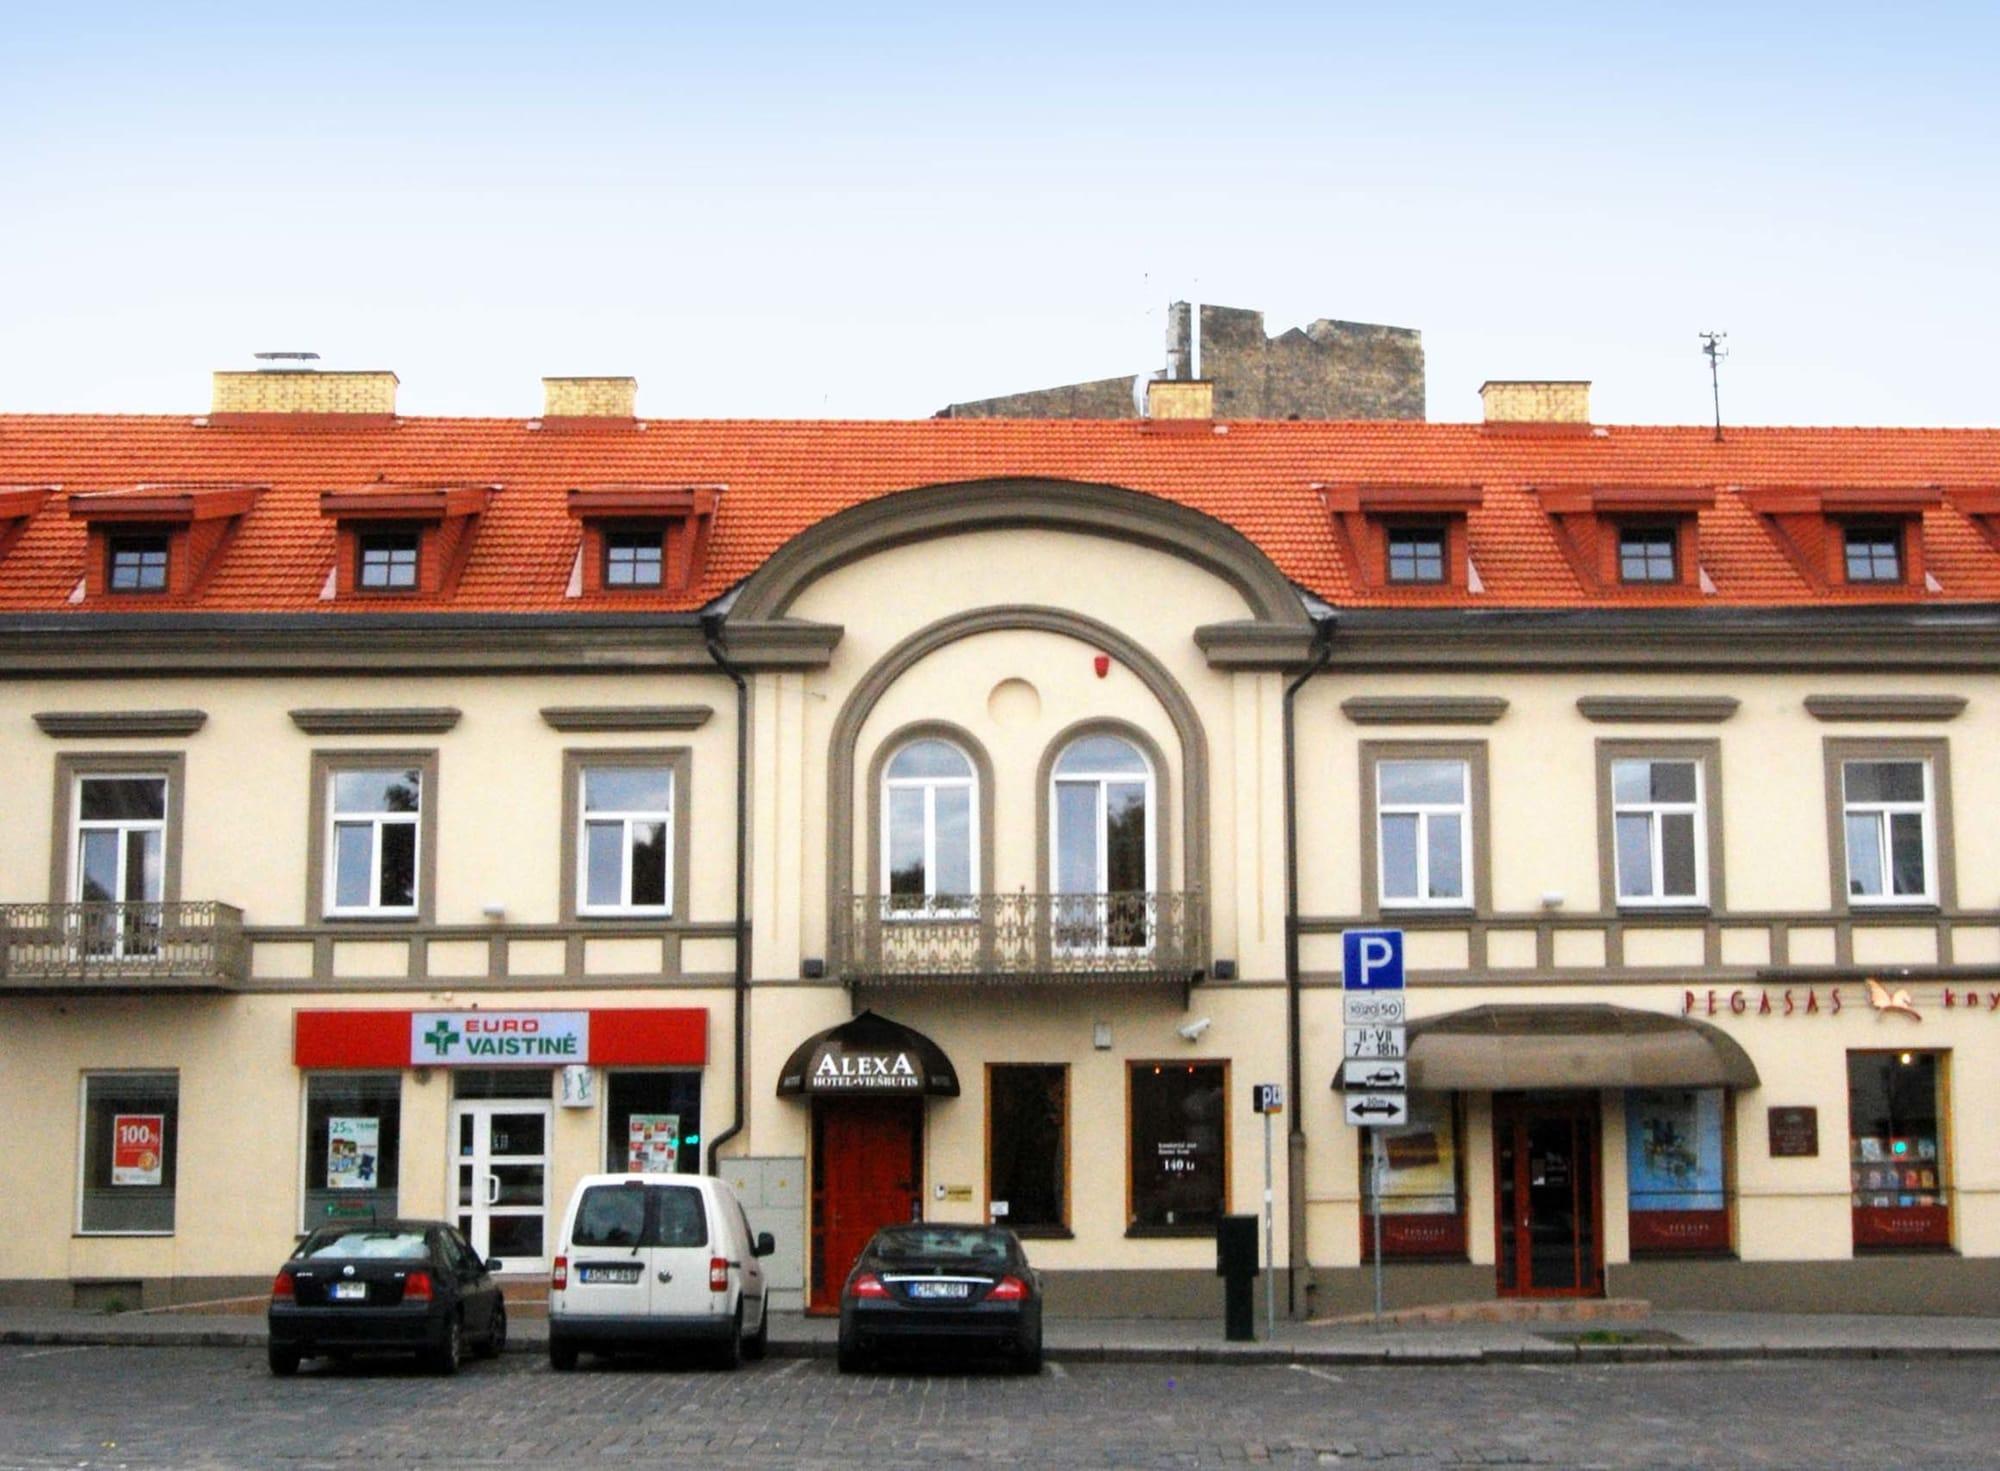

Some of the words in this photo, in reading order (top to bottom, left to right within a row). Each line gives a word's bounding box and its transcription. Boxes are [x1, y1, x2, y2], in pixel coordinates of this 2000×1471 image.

[1360, 937, 1393, 984] P
[1381, 1004, 1397, 1015] 50
[1686, 988, 1841, 1015] PEGASAS
[465, 1020, 539, 1033] EURO
[816, 1053, 914, 1076] ALEXA
[1164, 1159, 1184, 1171] 140
